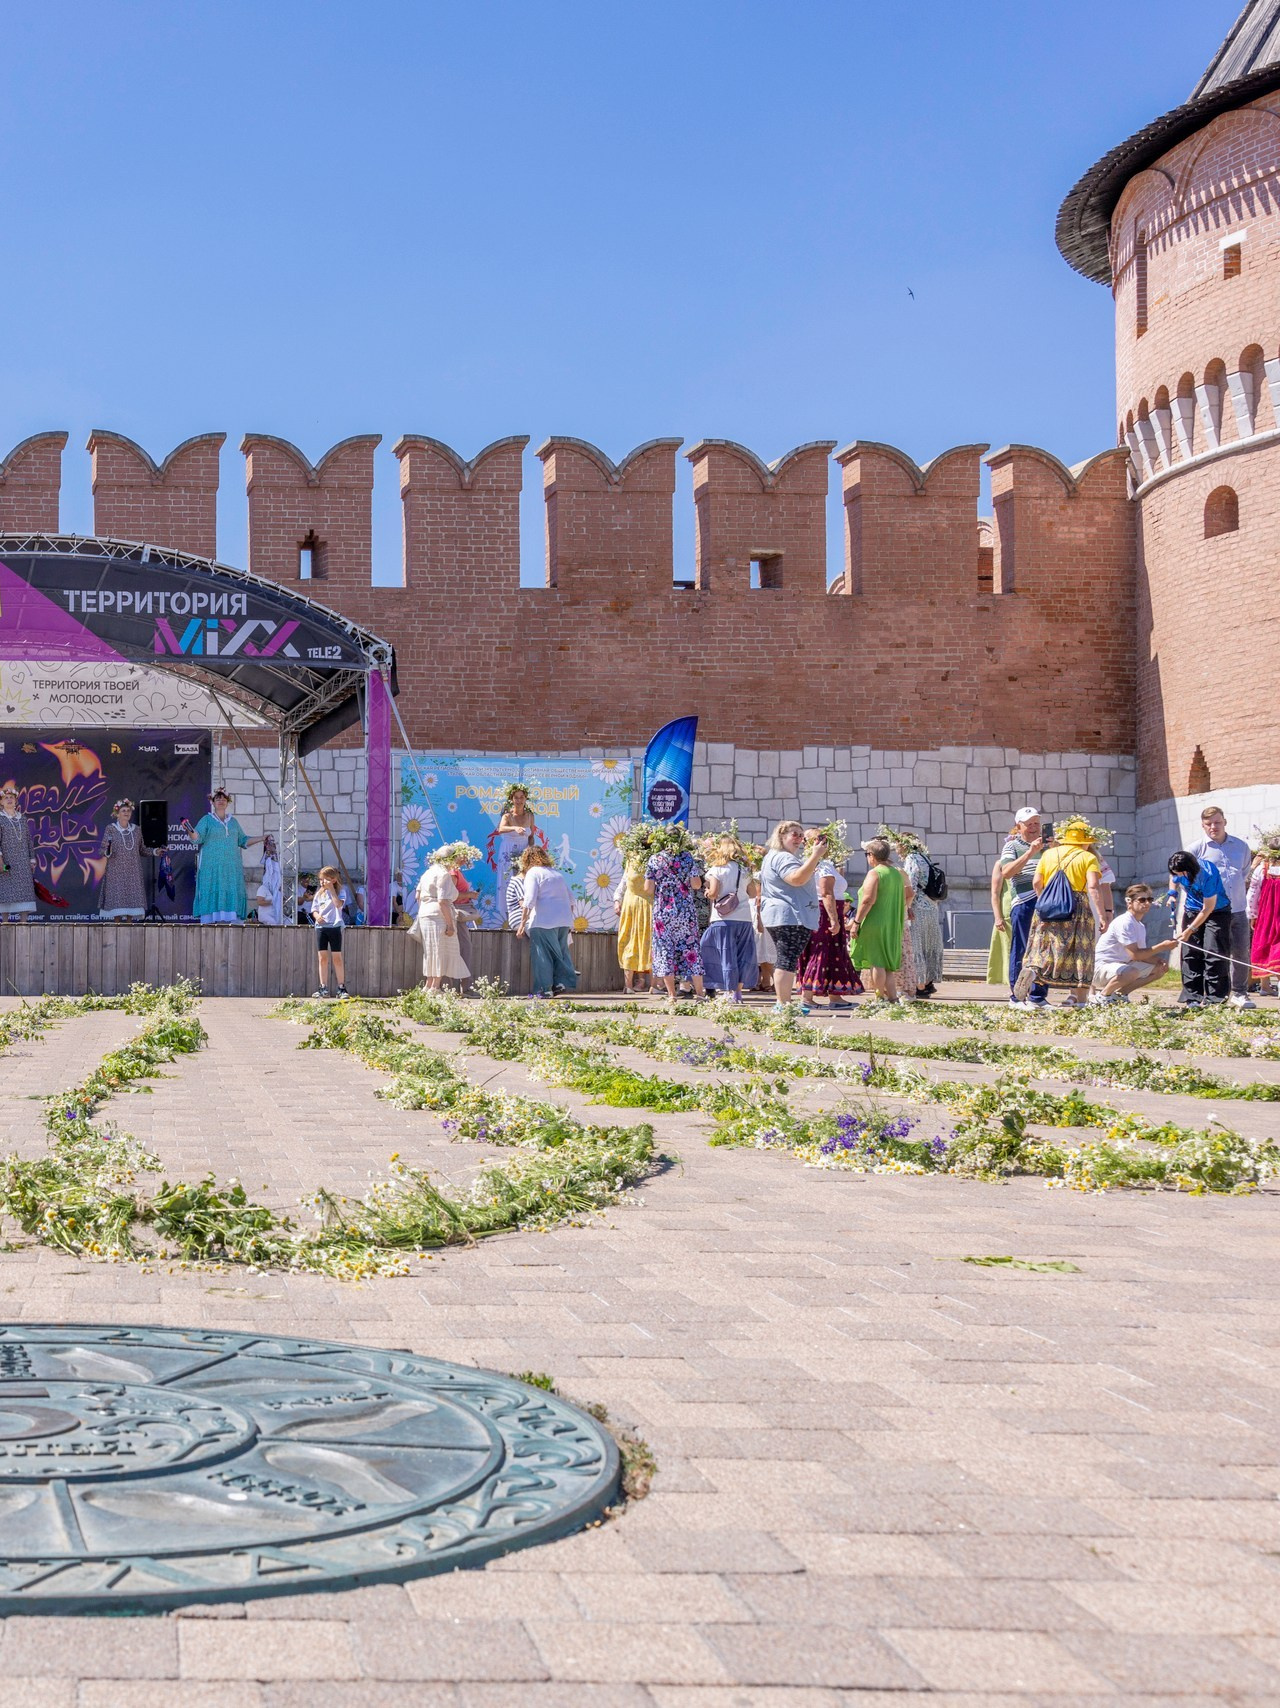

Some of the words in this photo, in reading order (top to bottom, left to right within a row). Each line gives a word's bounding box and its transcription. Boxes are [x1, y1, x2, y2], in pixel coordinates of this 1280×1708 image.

[63, 589, 247, 616] ТЕРРИТОРИЯ
[307, 645, 342, 660] TELE2
[33, 679, 101, 691] ТЕРРИТОРИЯ
[103, 678, 140, 691] ТВОЕЙ
[49, 693, 123, 705] МОЛОДОСТИ
[455, 785, 580, 802] РОМАОВЫЙ
